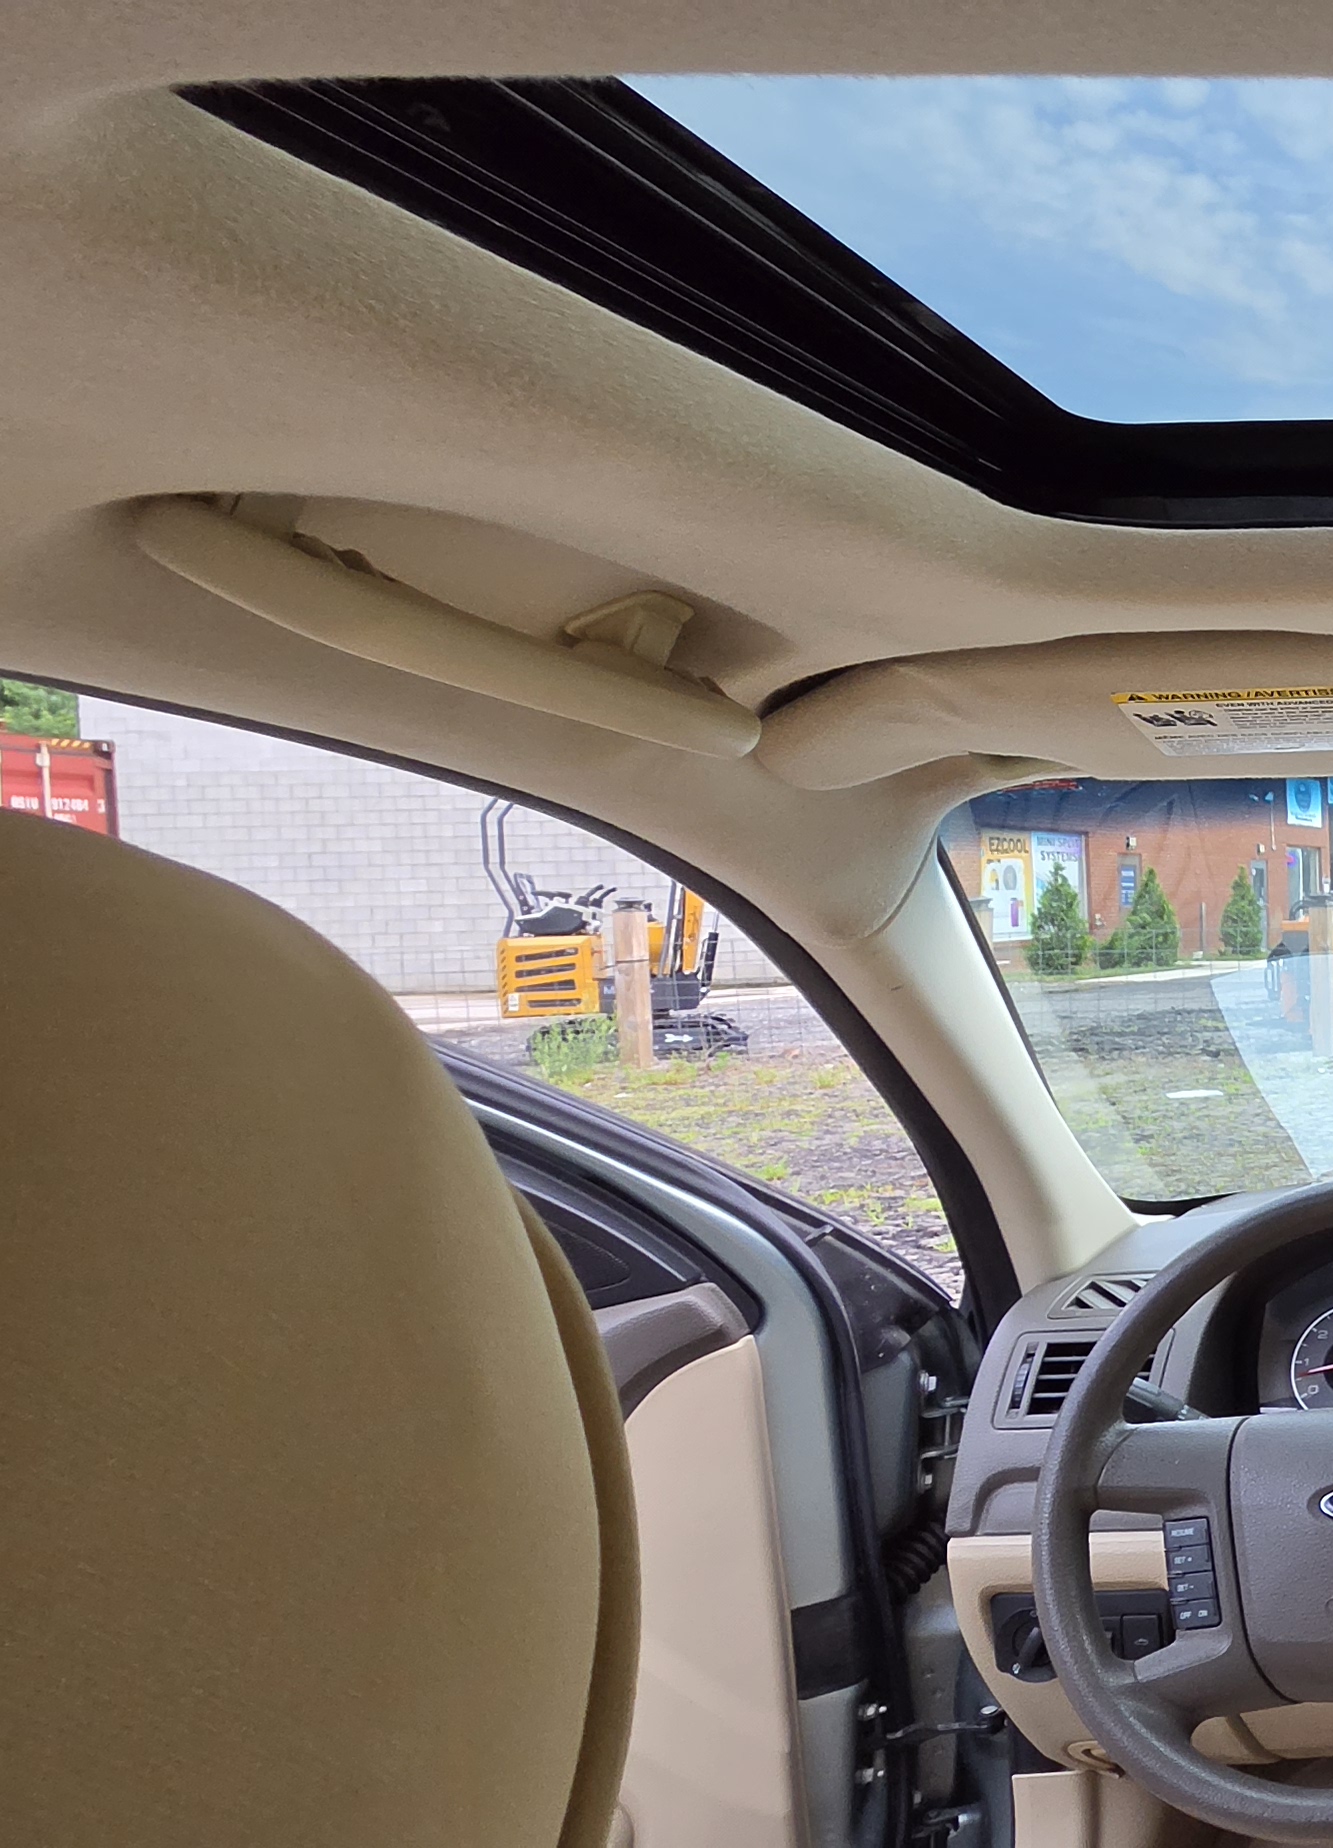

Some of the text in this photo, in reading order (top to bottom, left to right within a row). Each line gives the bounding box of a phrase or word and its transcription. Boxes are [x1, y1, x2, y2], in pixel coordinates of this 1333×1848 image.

[1151, 690, 1242, 701] WARNING
[988, 836, 1029, 854] EZCOOL
[1040, 850, 1079, 863] SYSTEMS
[1317, 1329, 1329, 1340] 2
[1303, 1358, 1310, 1366] 1
[1307, 1384, 1319, 1395] 0
[1179, 1611, 1192, 1620] OFF
